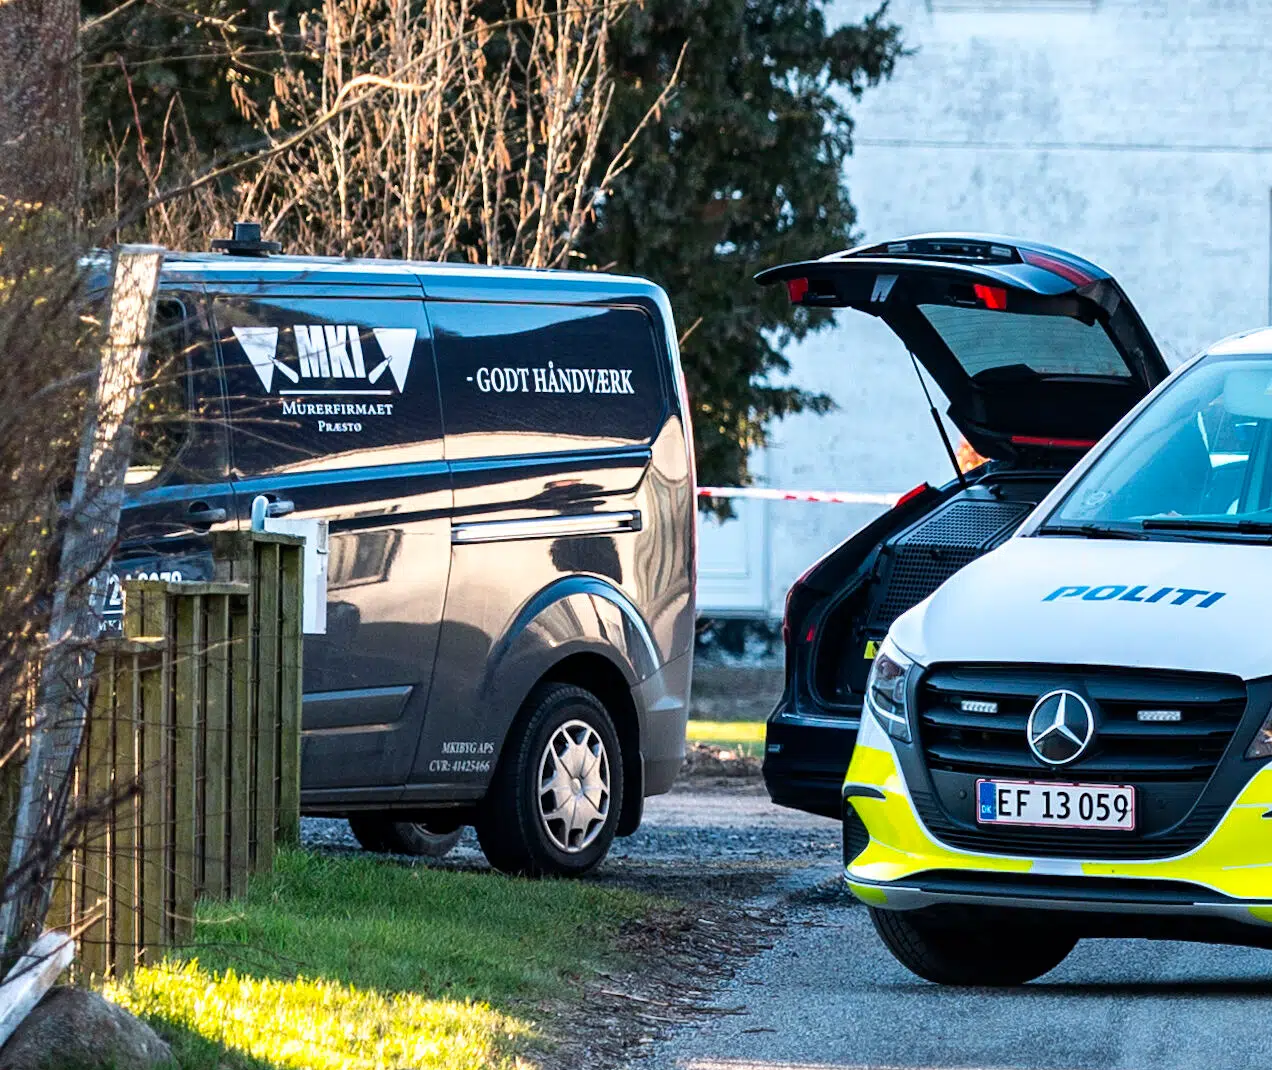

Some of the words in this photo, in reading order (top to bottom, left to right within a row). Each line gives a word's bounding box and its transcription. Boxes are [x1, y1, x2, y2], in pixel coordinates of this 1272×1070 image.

[293, 325, 367, 378] MKI
[476, 367, 529, 393] GODT
[532, 361, 635, 394] HÅNDVÆRK
[282, 402, 393, 415] MURERFIRMAET
[318, 420, 362, 432] PRÆSTØ
[1041, 585, 1226, 608] POLITI
[998, 788, 1031, 817] EF
[1042, 791, 1071, 819] 13
[1078, 792, 1129, 822] 059
